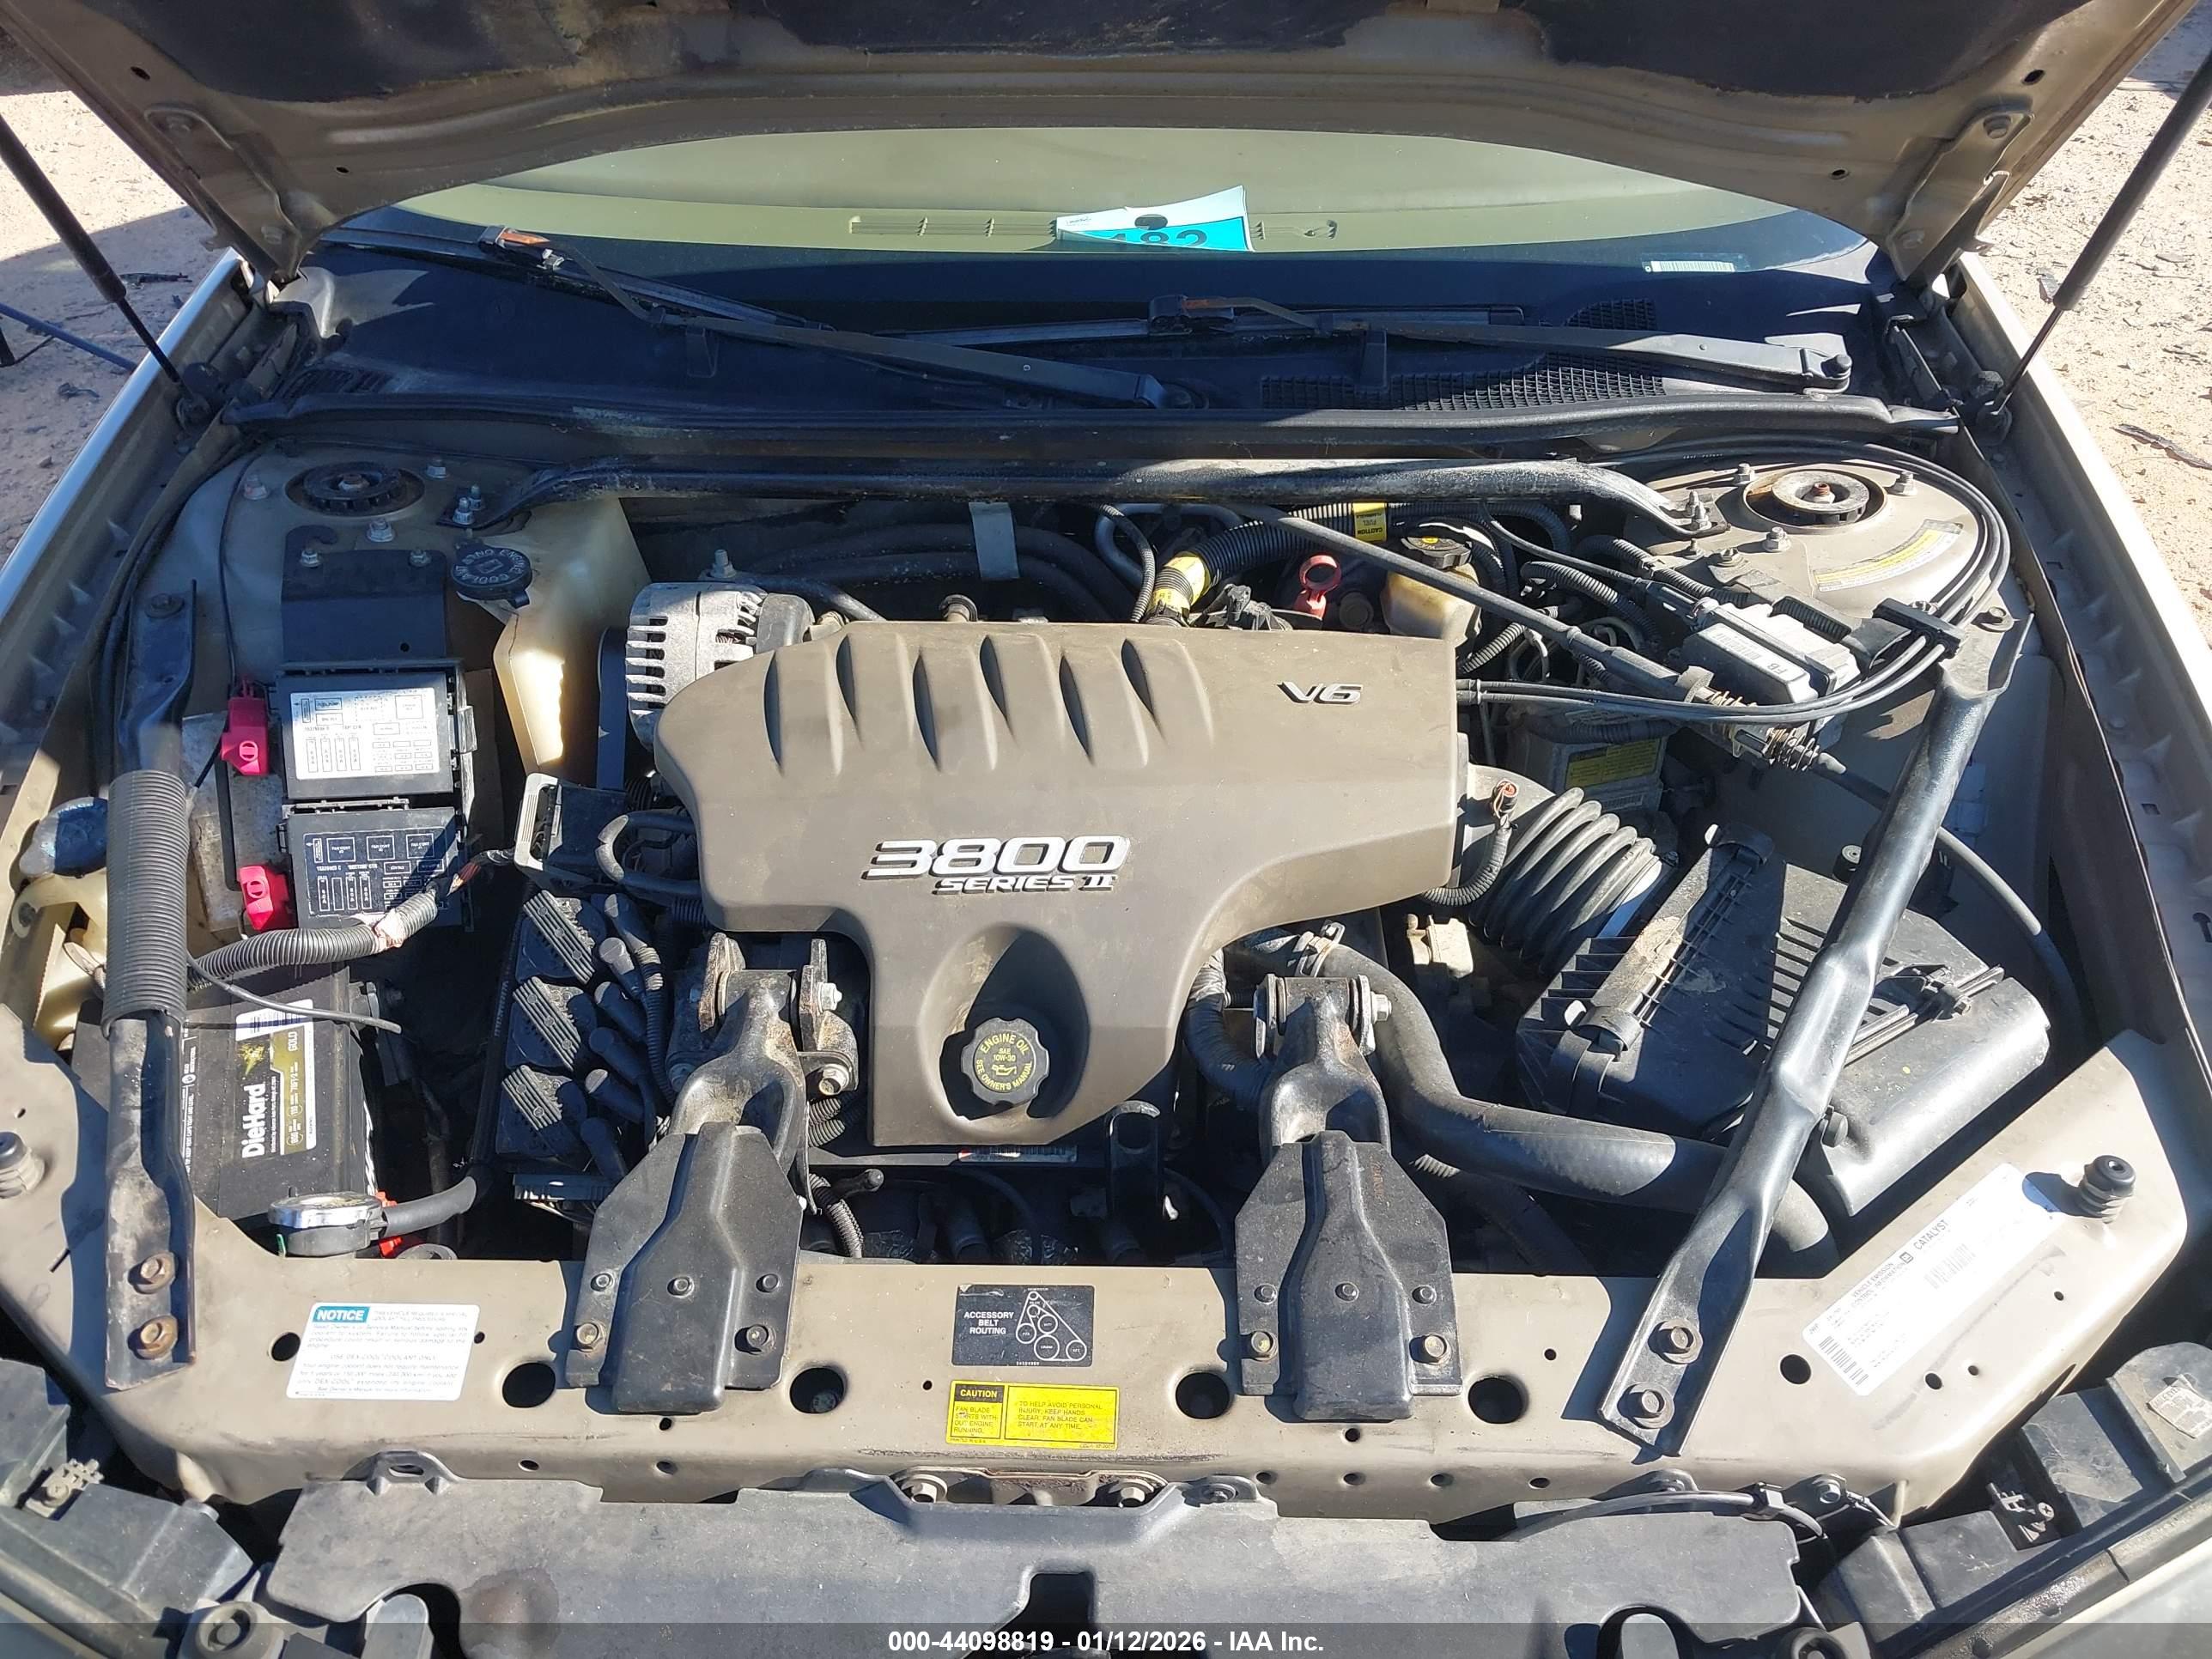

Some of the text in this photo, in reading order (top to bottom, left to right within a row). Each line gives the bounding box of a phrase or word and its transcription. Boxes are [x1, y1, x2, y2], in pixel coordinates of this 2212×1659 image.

[1277, 682, 1363, 704] V6
[861, 836, 1130, 879] 3800
[933, 874, 1117, 894] SERIES II
[289, 1032, 298, 1051] GOLD
[981, 1033, 1030, 1055] ENGINE OIL
[976, 1059, 1032, 1091] SEE OWNER'S MANUAL
[241, 1084, 265, 1158] DieHard
[1913, 1219, 1948, 1250] CATALYST
[317, 1310, 365, 1321] NOTICE
[960, 1389, 998, 1398] CAUTION
